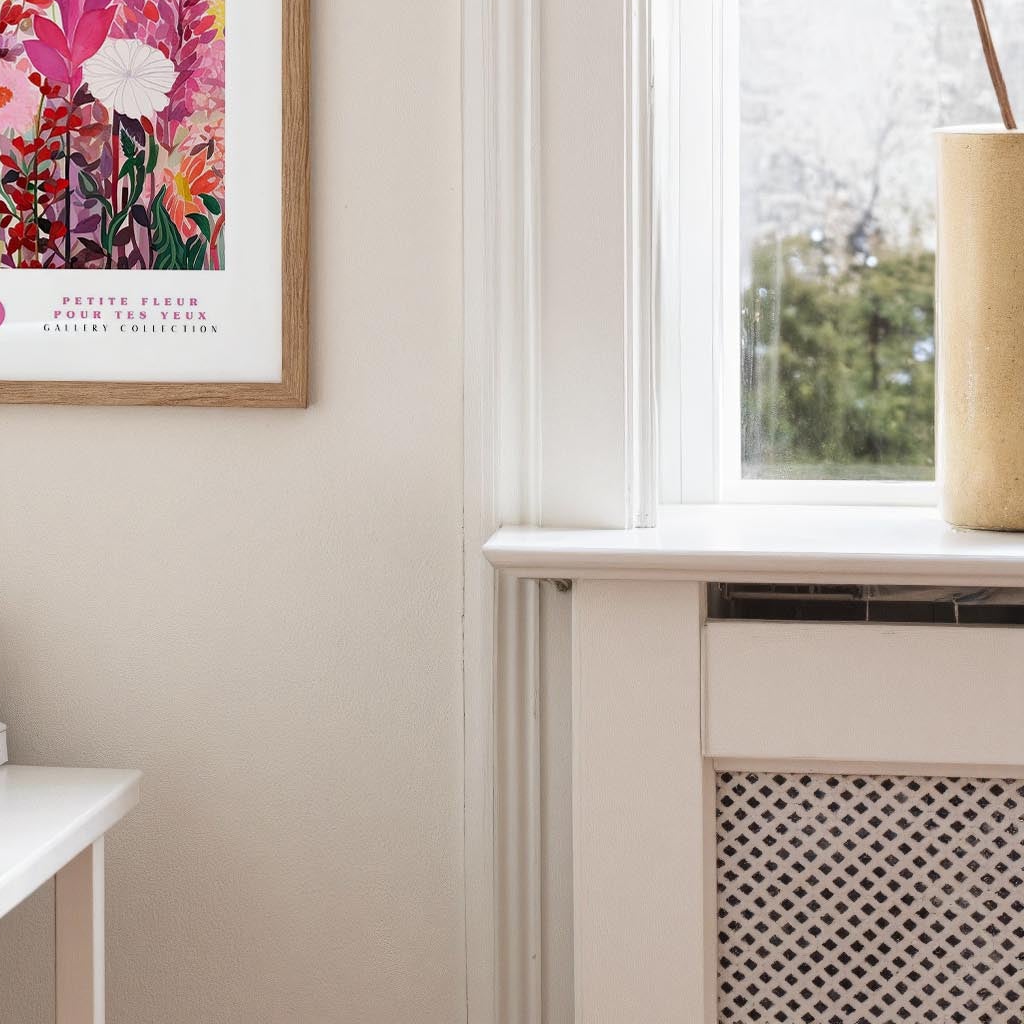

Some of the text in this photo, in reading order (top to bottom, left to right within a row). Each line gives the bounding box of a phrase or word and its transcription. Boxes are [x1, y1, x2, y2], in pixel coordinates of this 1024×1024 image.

[62, 296, 199, 307] PETITE FLEUR
[53, 310, 208, 321] POUR TES YEUX
